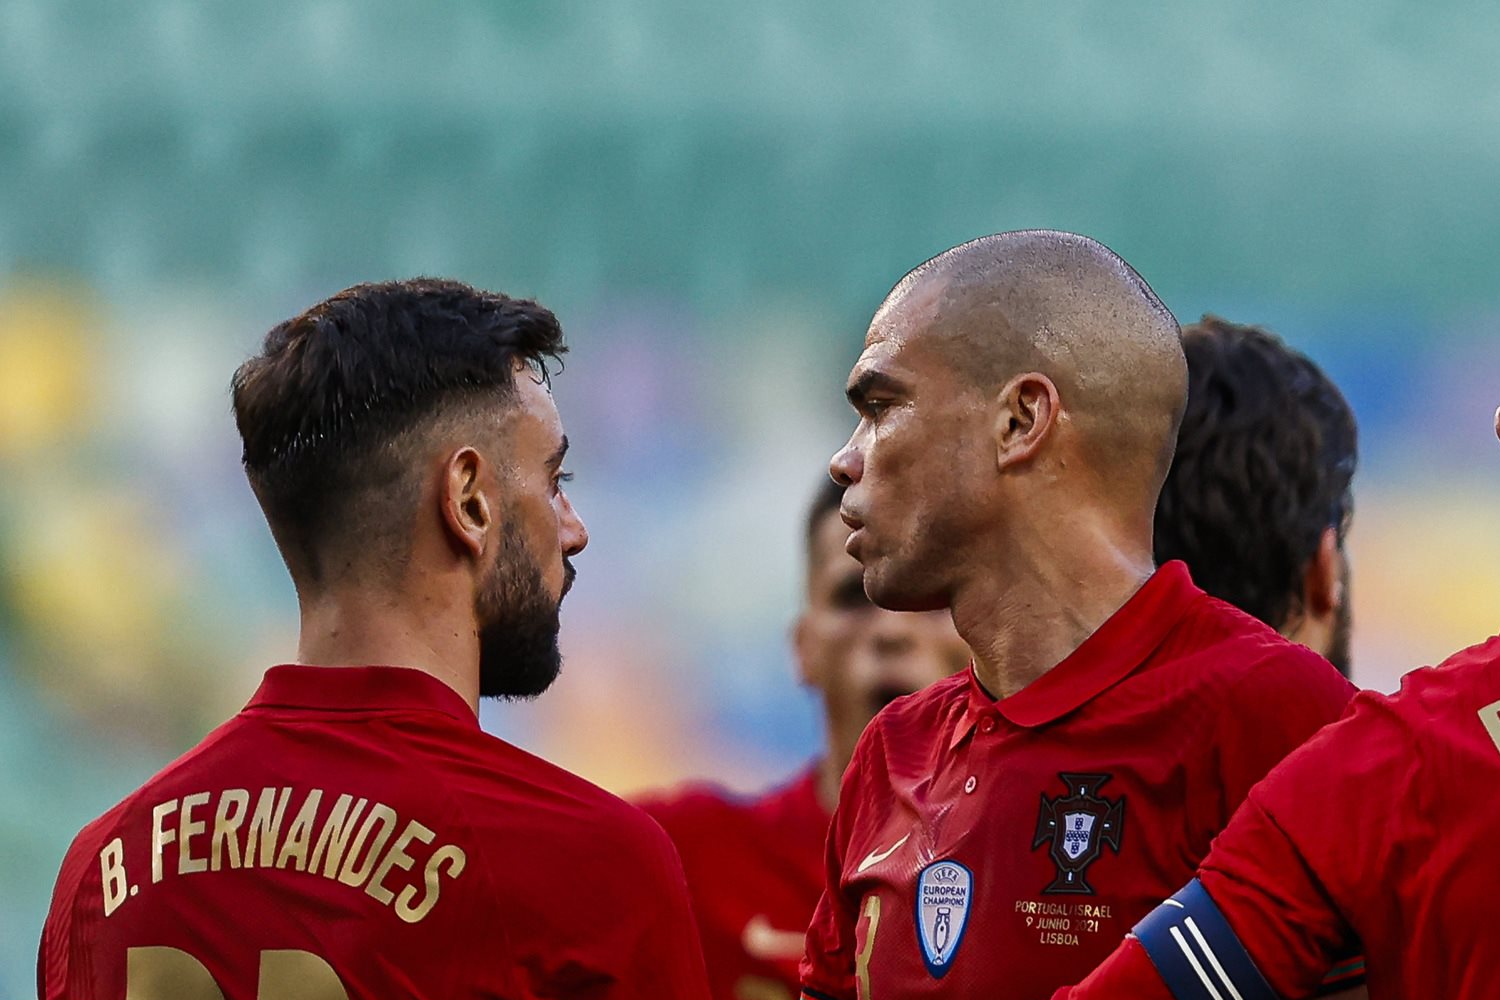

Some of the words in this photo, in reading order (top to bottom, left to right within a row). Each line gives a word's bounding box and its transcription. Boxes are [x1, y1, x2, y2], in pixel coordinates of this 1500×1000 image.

[100, 837, 139, 917] B.
[152, 787, 467, 923] FERNANDES
[934, 867, 959, 882] UEFA
[923, 885, 967, 896] EUROPEAN
[923, 896, 965, 906] CHAMPIONS
[1025, 916, 1034, 927] 9
[1036, 917, 1071, 931] JUNHO
[1073, 919, 1099, 933] 2021
[1040, 931, 1079, 945] LISBOA
